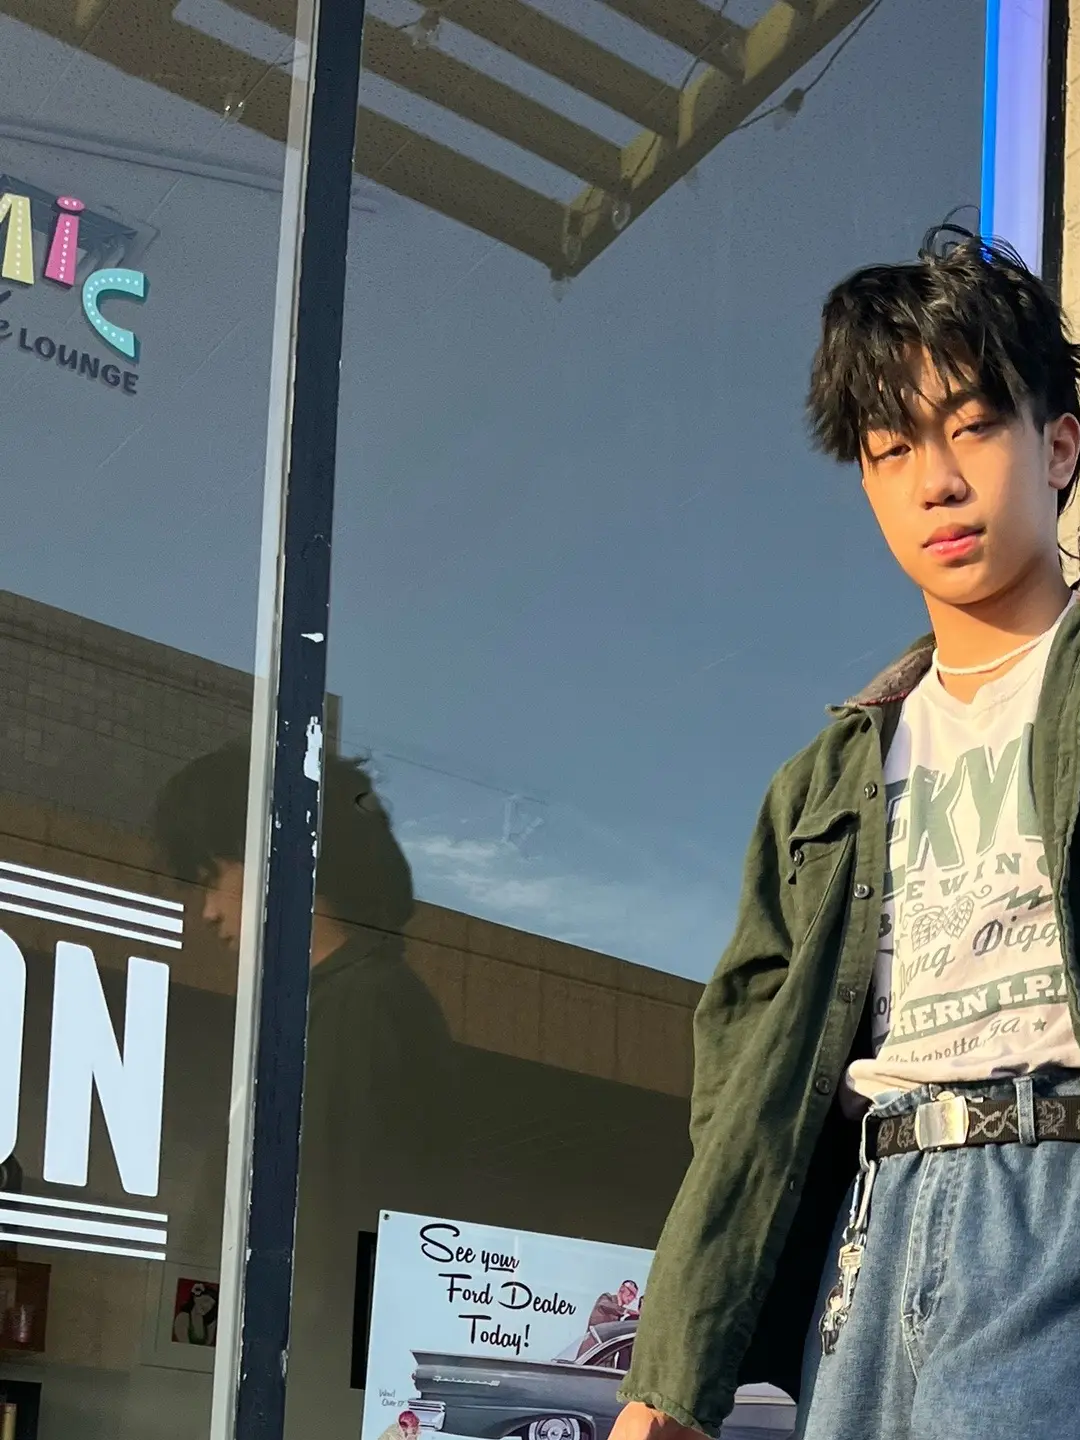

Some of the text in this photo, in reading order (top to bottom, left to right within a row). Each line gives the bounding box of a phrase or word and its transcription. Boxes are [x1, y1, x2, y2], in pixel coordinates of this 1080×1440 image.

[20, 328, 139, 395] LOUNGE
[419, 1222, 520, 1273] See your
[438, 1273, 577, 1315] Ford Dealer
[458, 1314, 530, 1356] Today!
